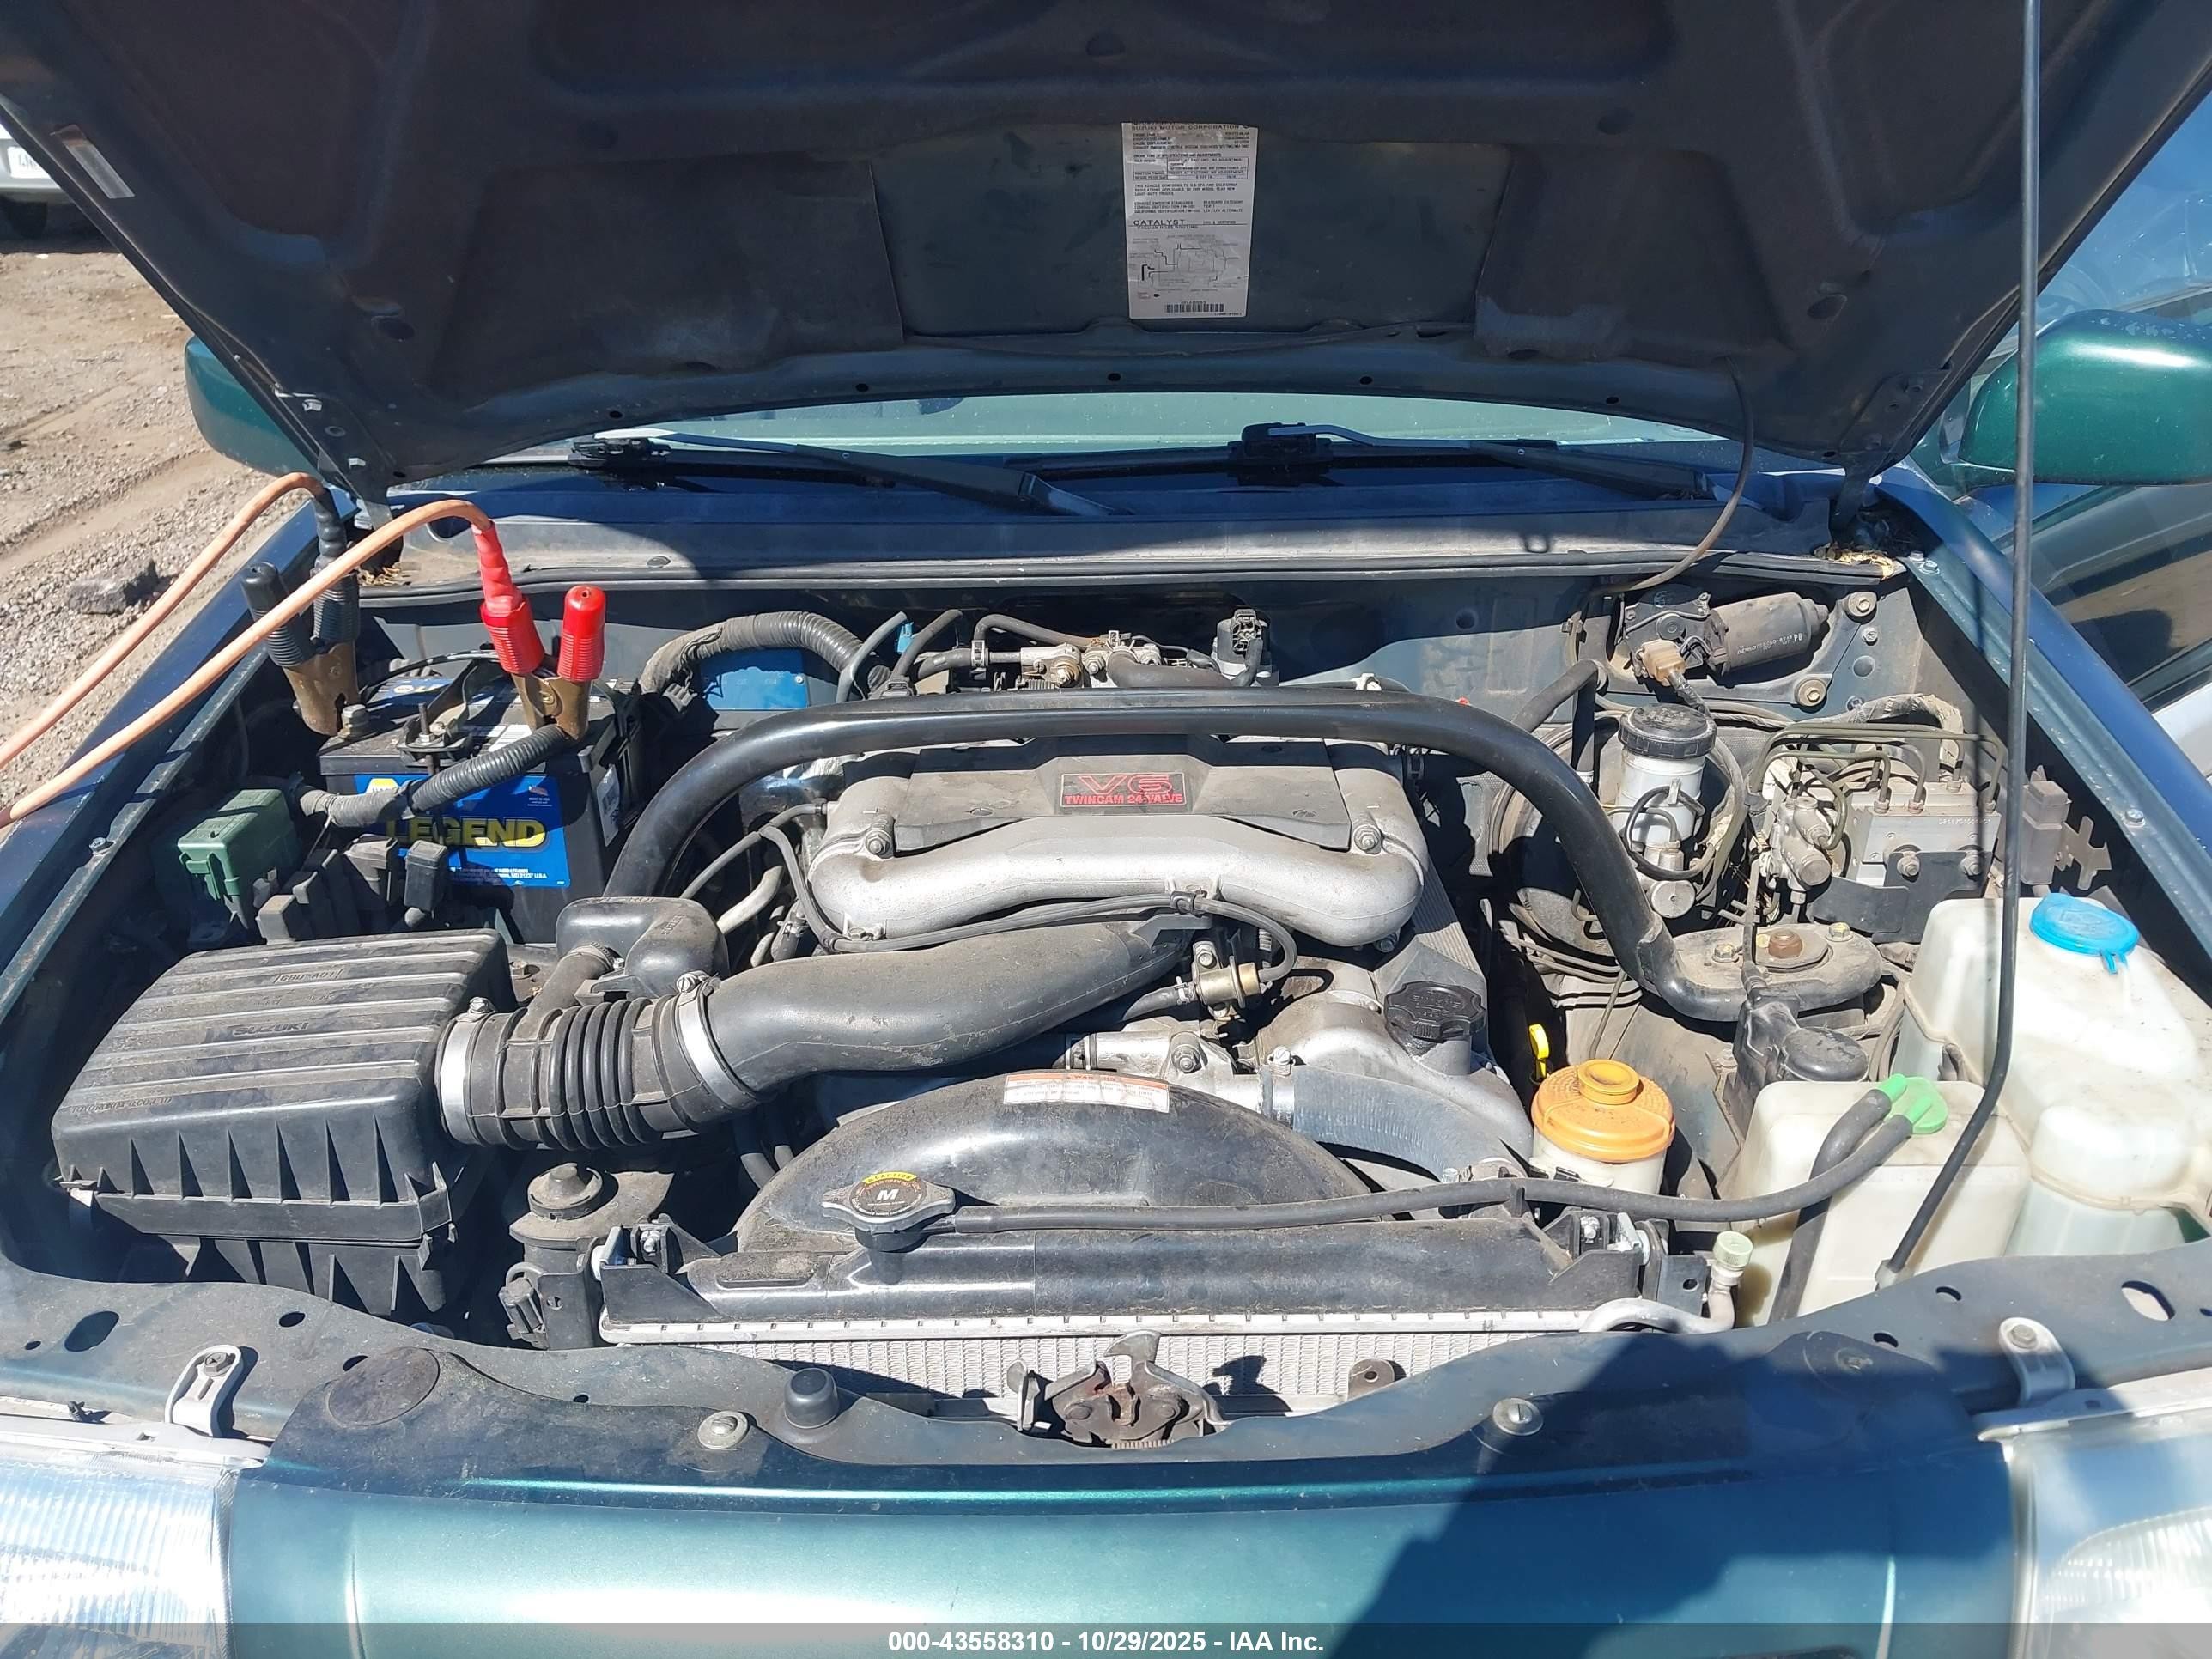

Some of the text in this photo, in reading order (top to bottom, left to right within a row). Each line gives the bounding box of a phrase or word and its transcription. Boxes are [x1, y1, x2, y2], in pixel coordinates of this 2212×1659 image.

[1078, 774, 1173, 795] V6
[1064, 793, 1183, 805] TWINCAM 24-VALVE
[385, 816, 548, 848] LEGEND
[232, 1021, 309, 1037] SUZUKI
